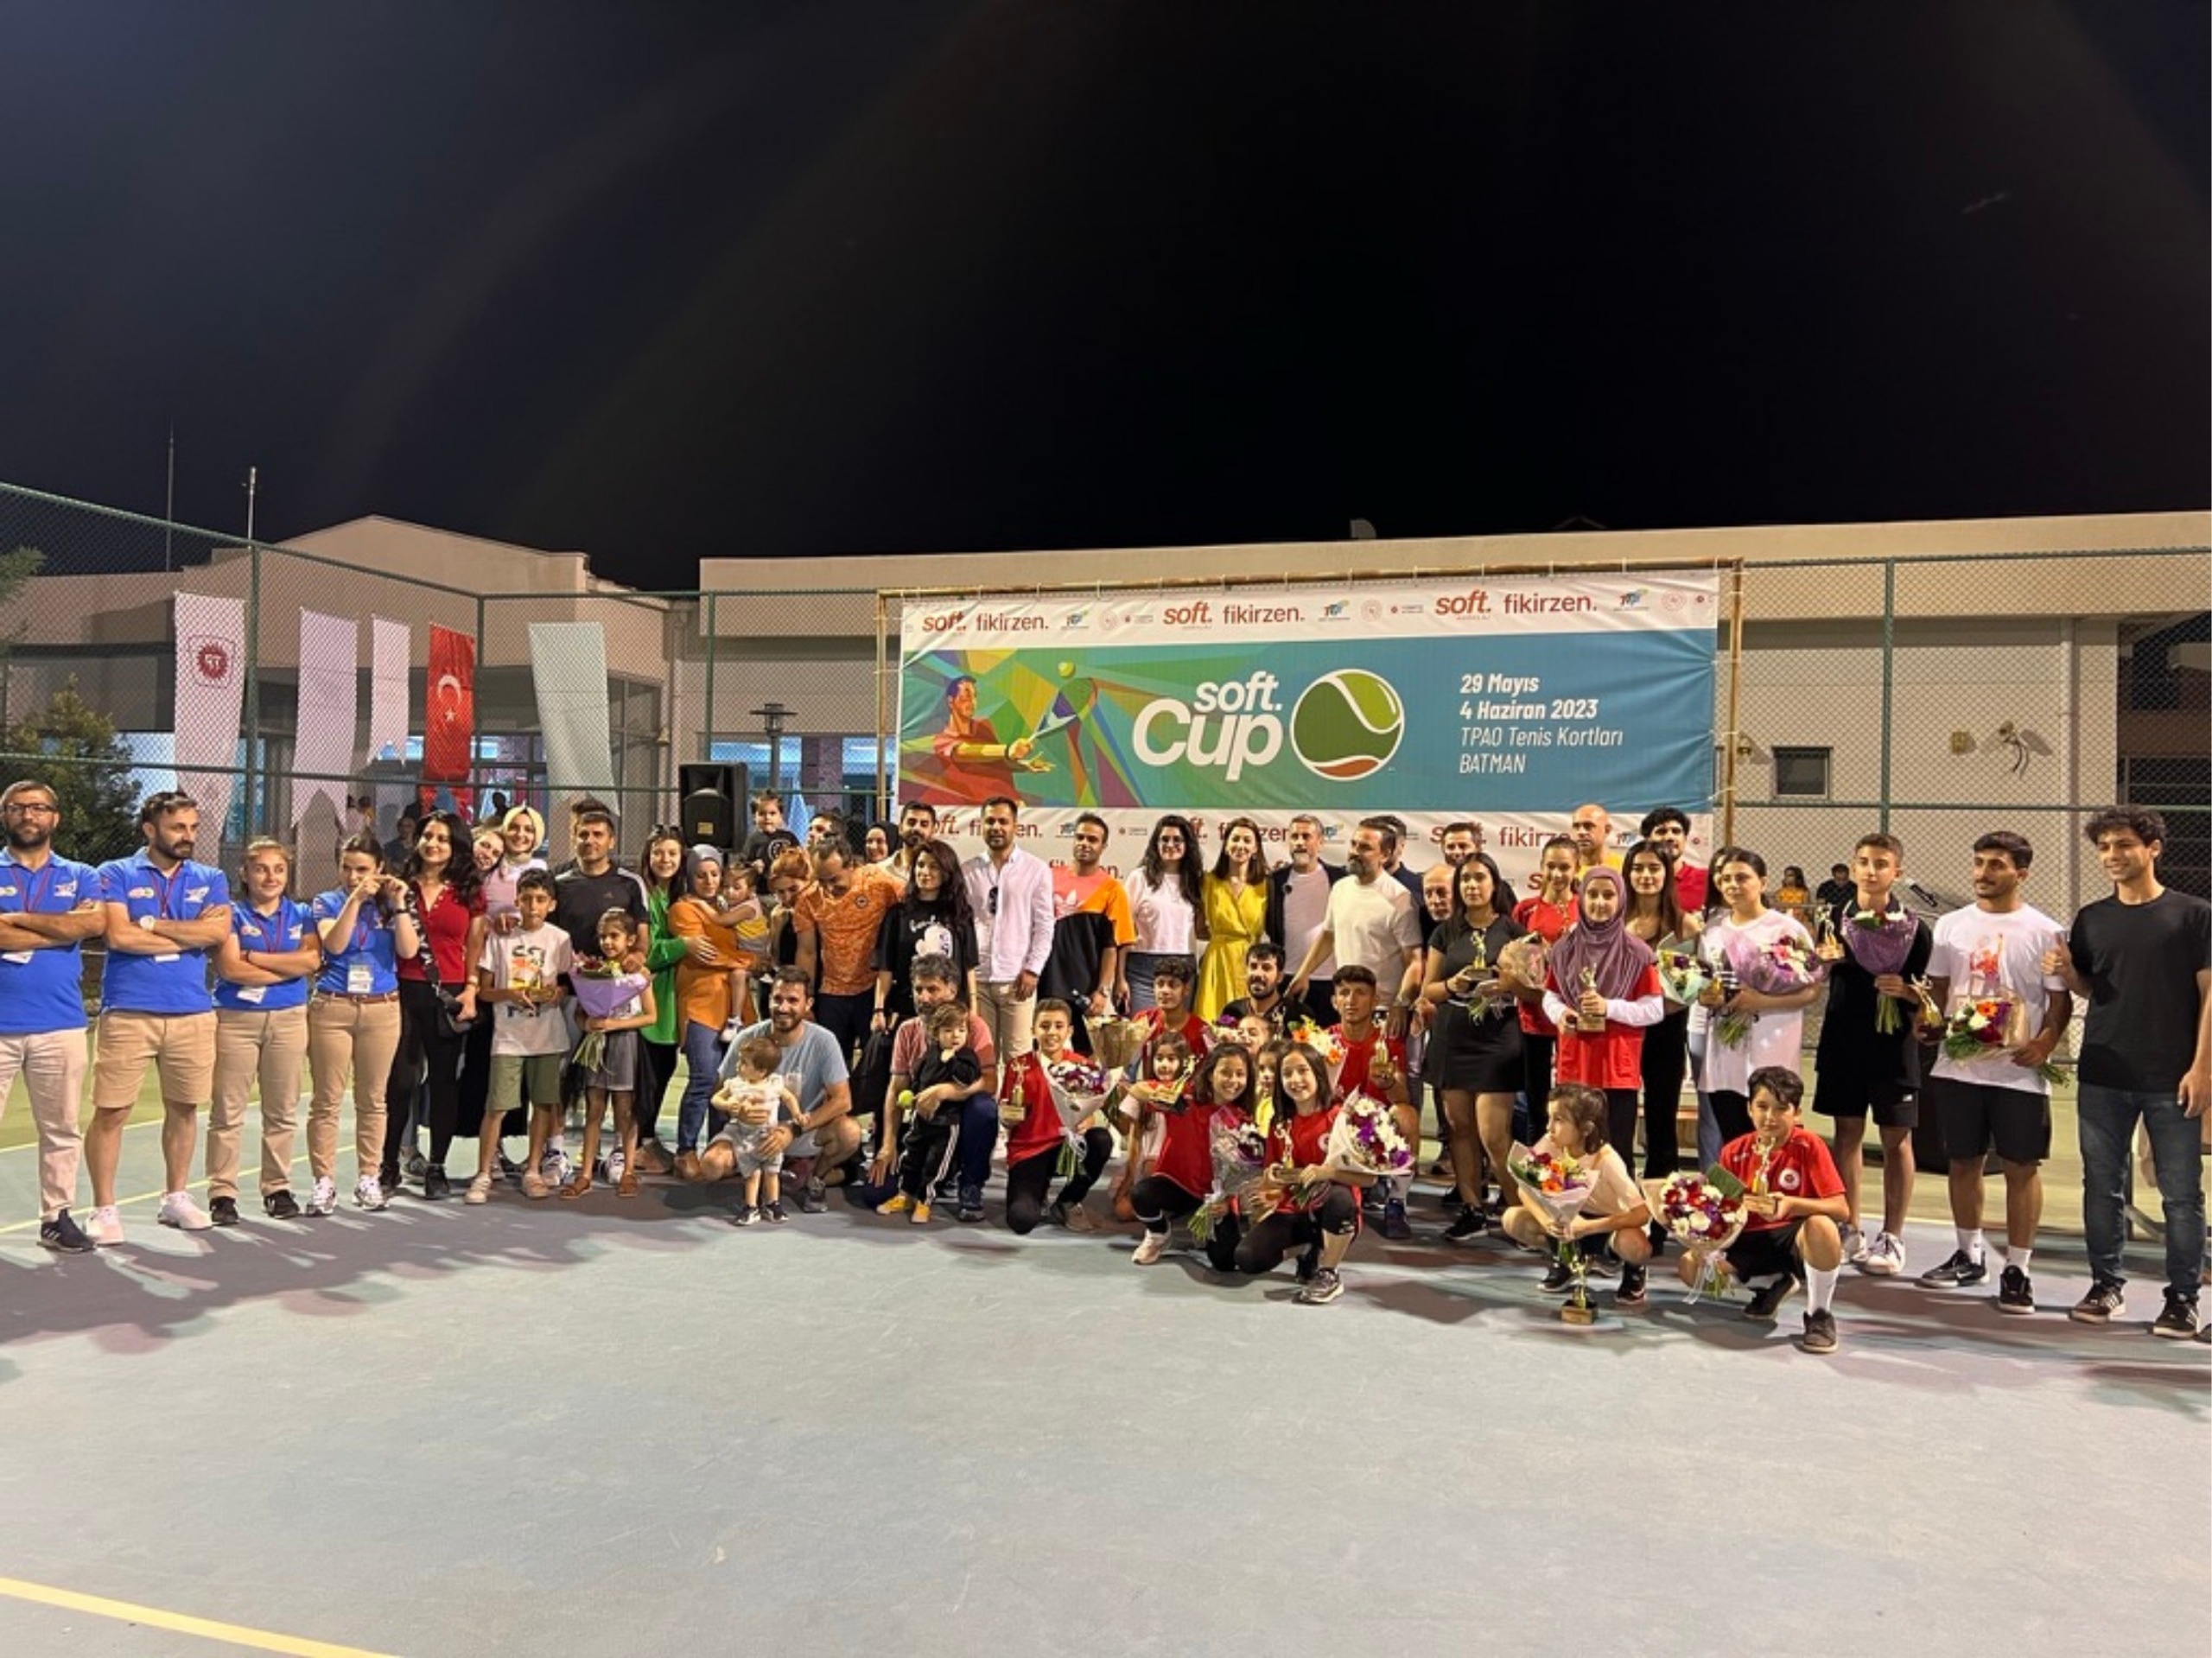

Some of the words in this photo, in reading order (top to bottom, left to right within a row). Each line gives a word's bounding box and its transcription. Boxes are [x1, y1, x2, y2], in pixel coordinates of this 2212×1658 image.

[1435, 589, 1491, 616] soft.
[1503, 593, 1597, 614] fikirzen.
[922, 611, 967, 632] soft.
[976, 613, 1049, 632] fikirzen.
[1162, 601, 1212, 626] soft.
[1223, 604, 1306, 625] fikirzen.
[1193, 670, 1284, 713] soft.
[1460, 673, 1484, 694] 29
[1488, 673, 1541, 697] Mayıs
[1460, 701, 1472, 720] 4
[1477, 699, 1546, 720] Haziran
[1550, 698, 1599, 720] 2023
[1133, 697, 1284, 782] Cup
[1461, 727, 1503, 746] TPAO
[1509, 727, 1552, 746] Tenis
[1557, 726, 1624, 746] Kortları
[1459, 753, 1526, 774] BATMAN
